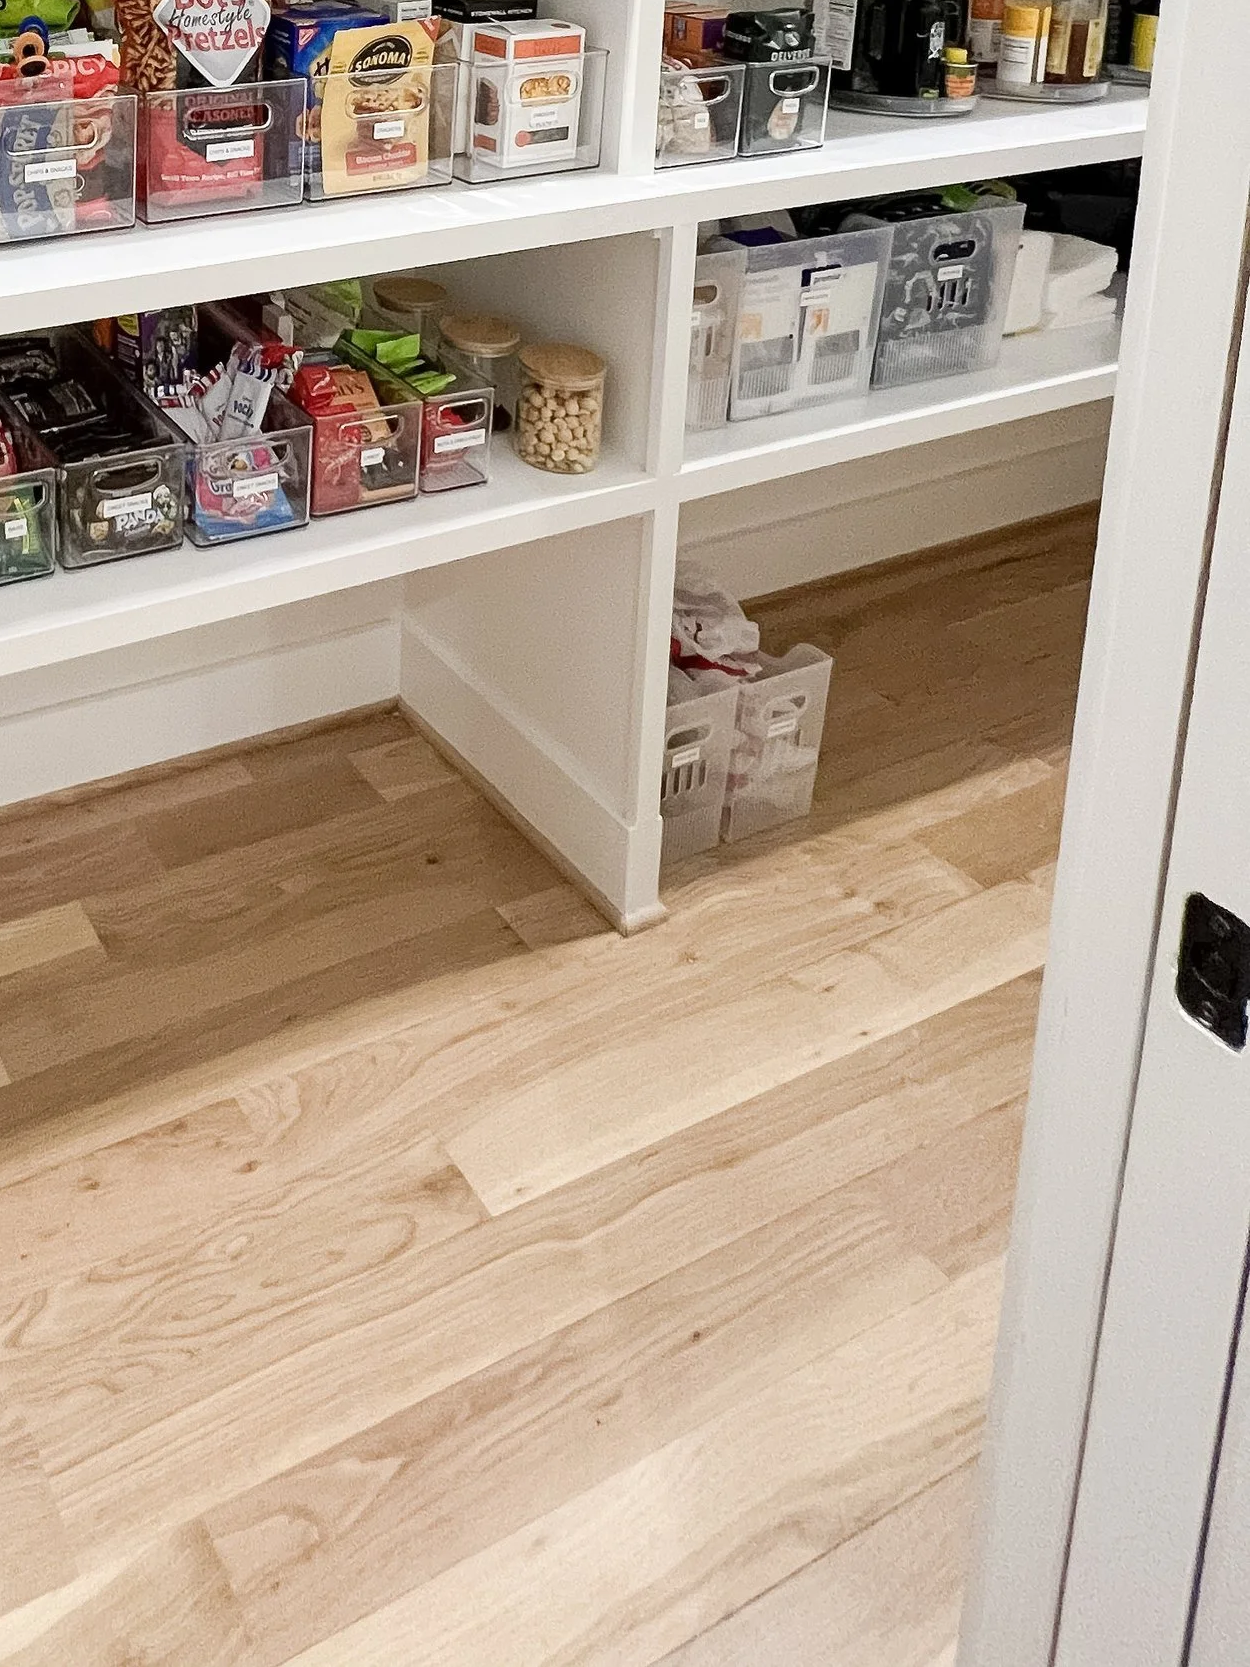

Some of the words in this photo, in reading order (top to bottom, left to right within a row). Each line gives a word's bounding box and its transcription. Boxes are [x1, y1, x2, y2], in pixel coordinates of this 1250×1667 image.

[168, 3, 253, 33] Homestyle
[166, 16, 266, 53] Pretzels
[355, 51, 406, 73] SONOMA
[114, 508, 166, 534] PANDA
